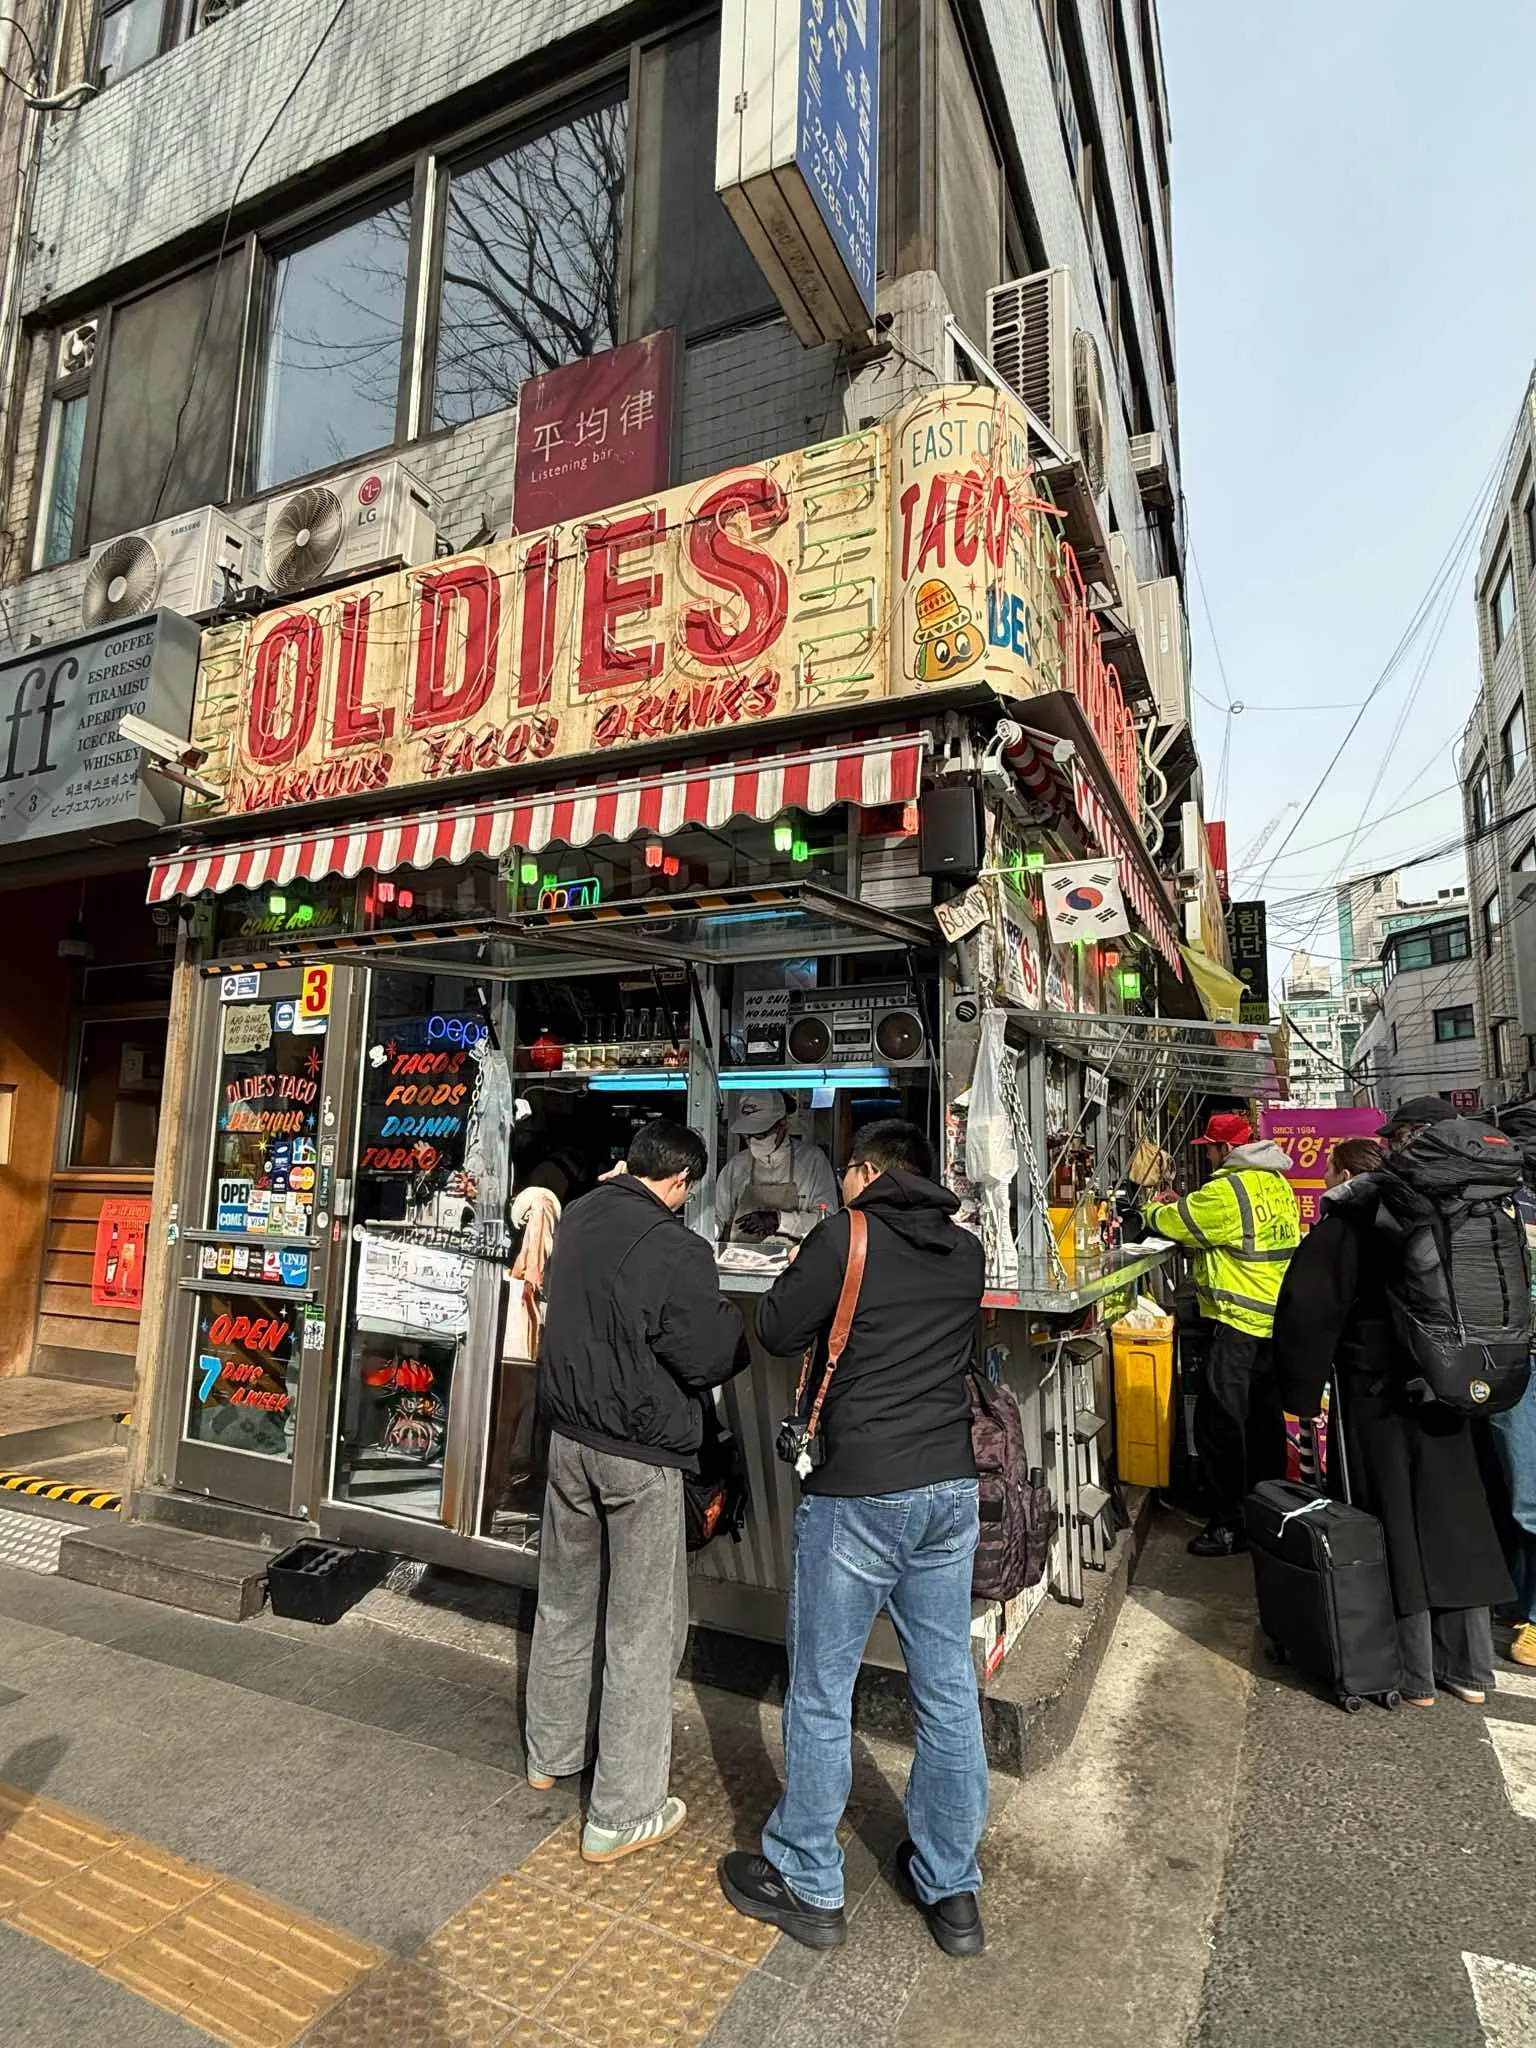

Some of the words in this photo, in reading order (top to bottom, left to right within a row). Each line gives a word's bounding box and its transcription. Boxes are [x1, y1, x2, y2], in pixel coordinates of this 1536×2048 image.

[531, 389, 656, 463] 平均律
[912, 419, 968, 468] EAST
[531, 456, 588, 483] Listening
[592, 448, 613, 464] bar
[170, 519, 201, 536] SAMSUNG
[358, 508, 377, 526] LG
[900, 469, 1011, 582] TACO
[246, 470, 789, 768] OLDIES
[104, 632, 154, 658] COFFEE
[87, 654, 152, 684] ESPRESSO
[87, 678, 150, 706] TIRAMISU
[77, 701, 146, 730] APERITIVO
[234, 749, 393, 812] VARIOUS
[421, 711, 560, 779] TACOS
[594, 666, 781, 746] DRINKS
[82, 746, 143, 772] WHISKEY
[28, 794, 38, 813] 3
[240, 915, 284, 936] COME
[305, 969, 328, 1012] 3
[746, 995, 763, 1005] NO
[231, 1016, 244, 1025] NO
[745, 1010, 760, 1018] NO
[391, 1051, 466, 1076] TACOS
[226, 1074, 276, 1105] OLDIES
[277, 1073, 317, 1105] TACO
[385, 1082, 468, 1107] FOODS
[1272, 1126, 1294, 1134] SINCE
[220, 1212, 242, 1226] COME
[251, 1217, 265, 1227] VISA
[208, 1312, 290, 1352] OPEN
[198, 1354, 223, 1405] 7
[222, 1361, 264, 1385] DAYS
[230, 1386, 245, 1406] A
[245, 1389, 291, 1412] WEEK
